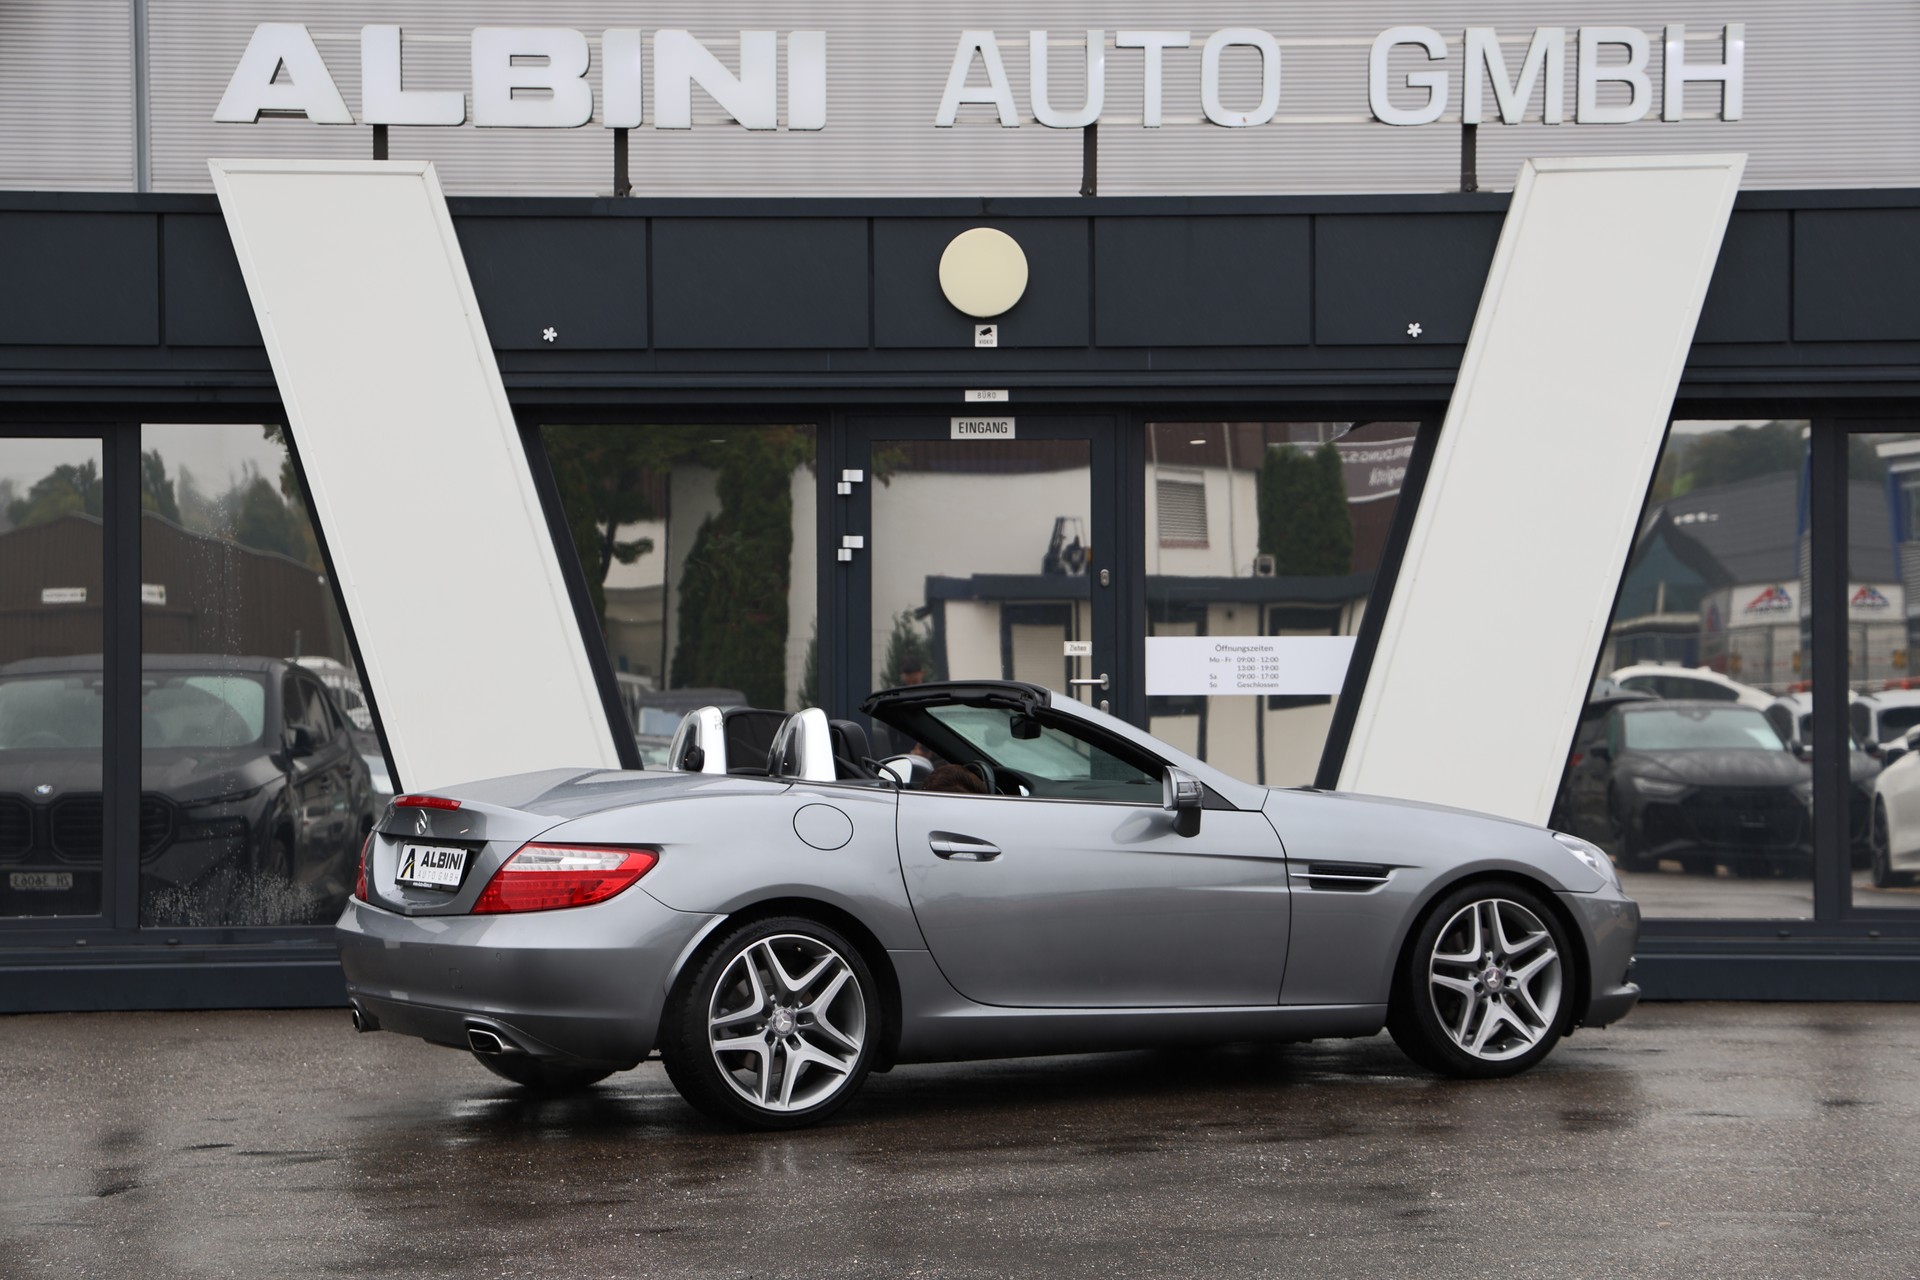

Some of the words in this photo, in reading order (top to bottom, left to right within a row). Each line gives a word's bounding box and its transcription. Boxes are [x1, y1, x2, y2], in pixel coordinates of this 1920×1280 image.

[212, 22, 827, 130] ALBINI
[935, 27, 1281, 129] AUTO
[1368, 23, 1745, 126] GMBH
[977, 391, 997, 399] BÜRO
[958, 421, 1008, 434] EINGANG
[1069, 644, 1087, 652] Ziehen
[1215, 643, 1274, 653] Öffnungszeiten
[420, 850, 464, 870] ALBINI
[417, 870, 436, 880] AUTO
[438, 871, 460, 882] GMBH
